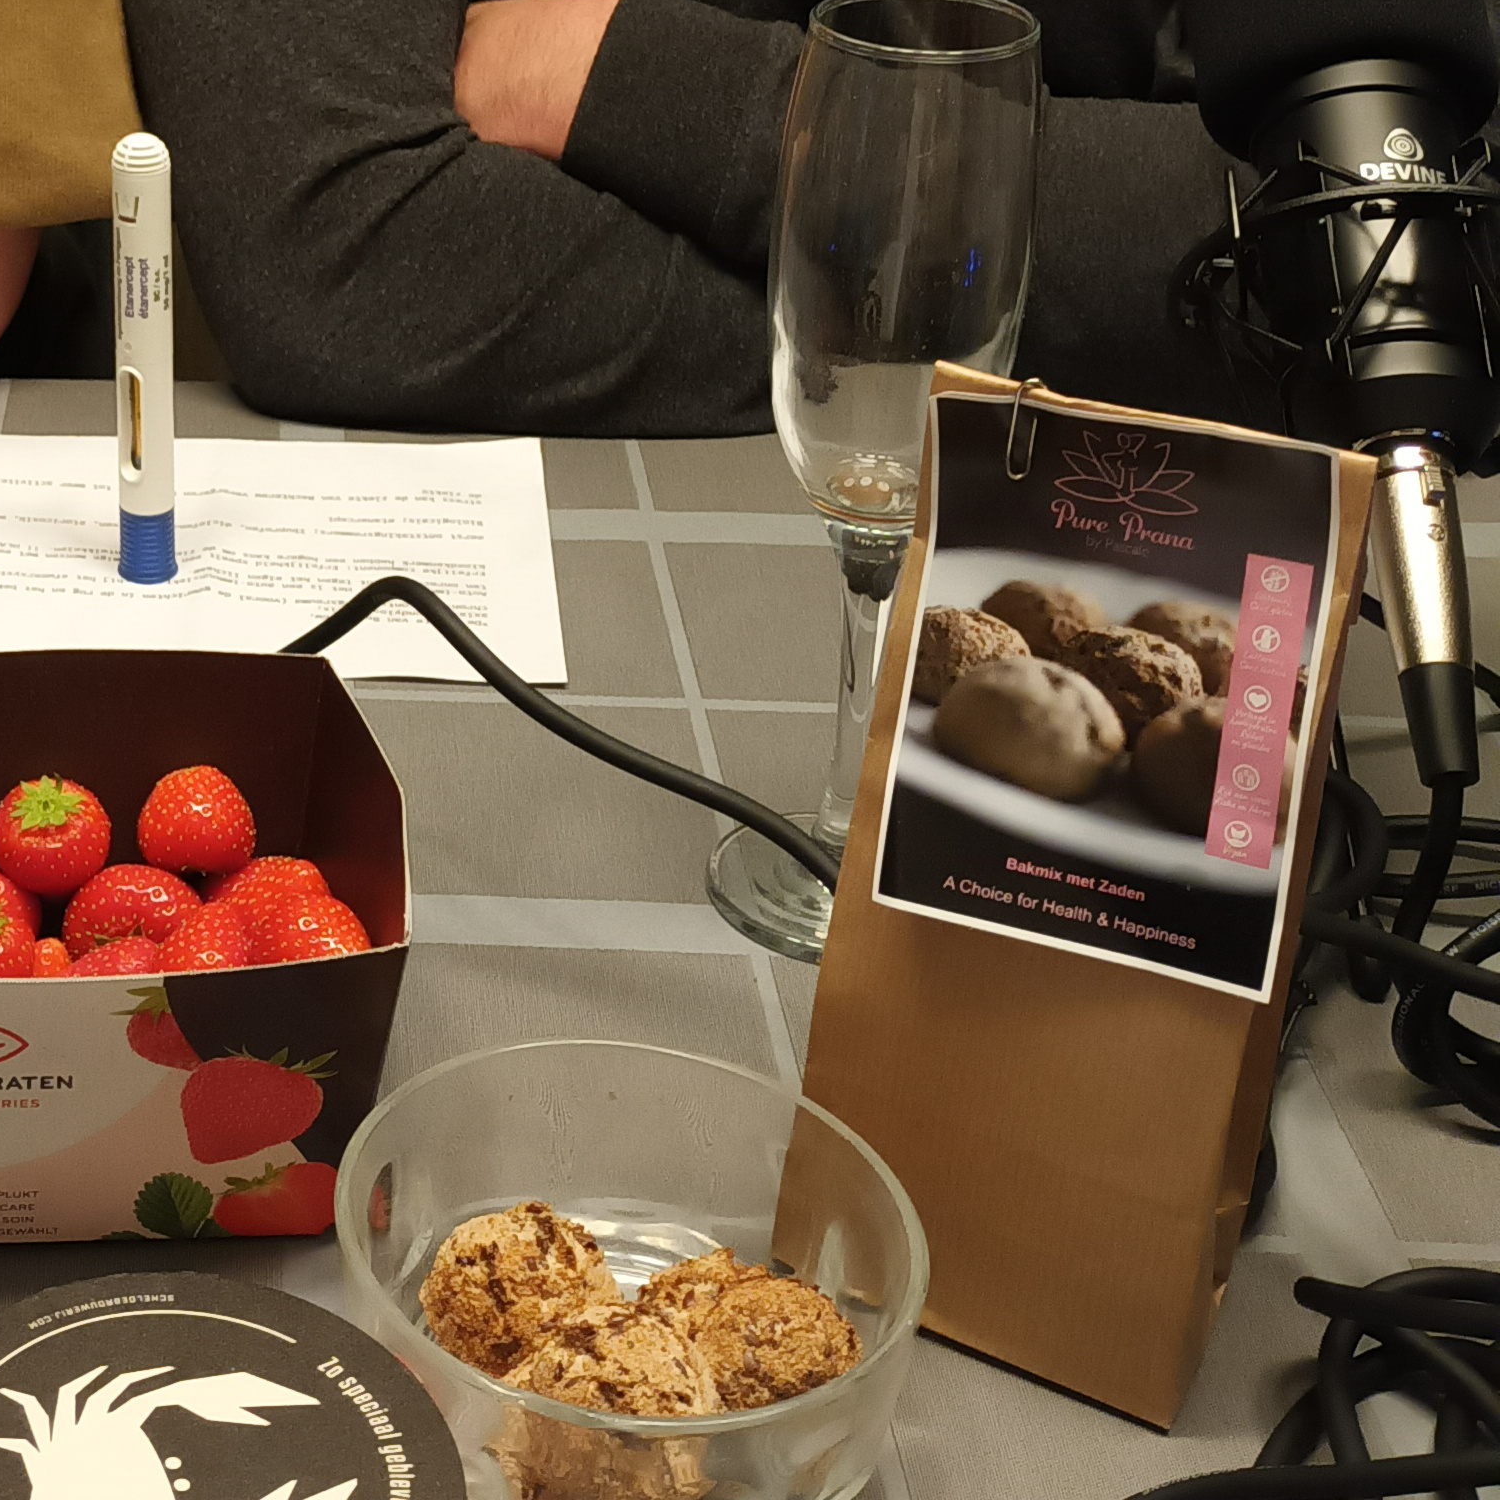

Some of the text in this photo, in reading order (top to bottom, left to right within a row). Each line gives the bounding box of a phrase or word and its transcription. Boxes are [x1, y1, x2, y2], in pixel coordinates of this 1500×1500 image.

[1360, 163, 1447, 185] DEVINE
[124, 256, 136, 318] Etanercept
[1051, 499, 1195, 550] Pure Prana
[1005, 857, 1146, 902] Bakmix met Zaden
[942, 875, 1197, 950] A Choice for Health & Happiness
[2, 1215, 35, 1225] SOIN
[27, 1294, 175, 1330] SCHELDEBROUWERIJ.COM
[316, 1355, 416, 1500] Zo speciaal geblev
